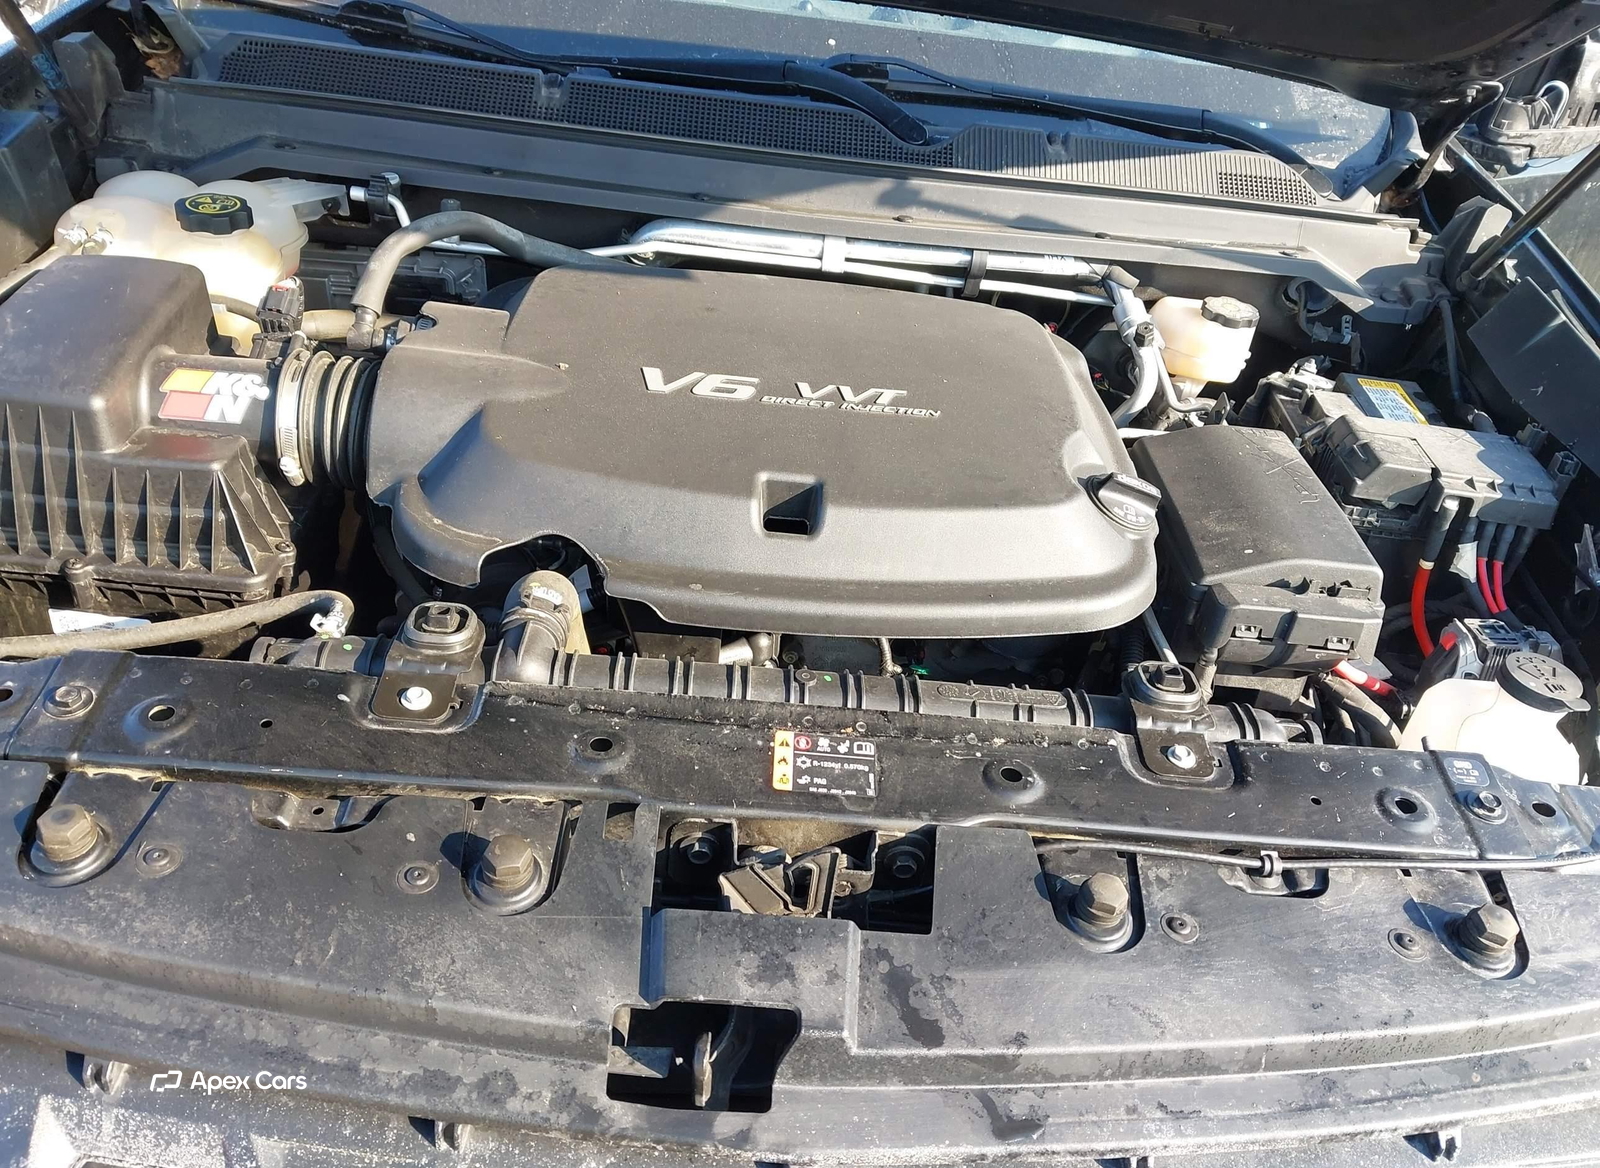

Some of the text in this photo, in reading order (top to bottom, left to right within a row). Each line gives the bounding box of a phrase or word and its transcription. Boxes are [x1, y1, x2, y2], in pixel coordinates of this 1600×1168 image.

[640, 366, 908, 405] V6 VVT
[759, 394, 941, 418] DIRECT INJECTION
